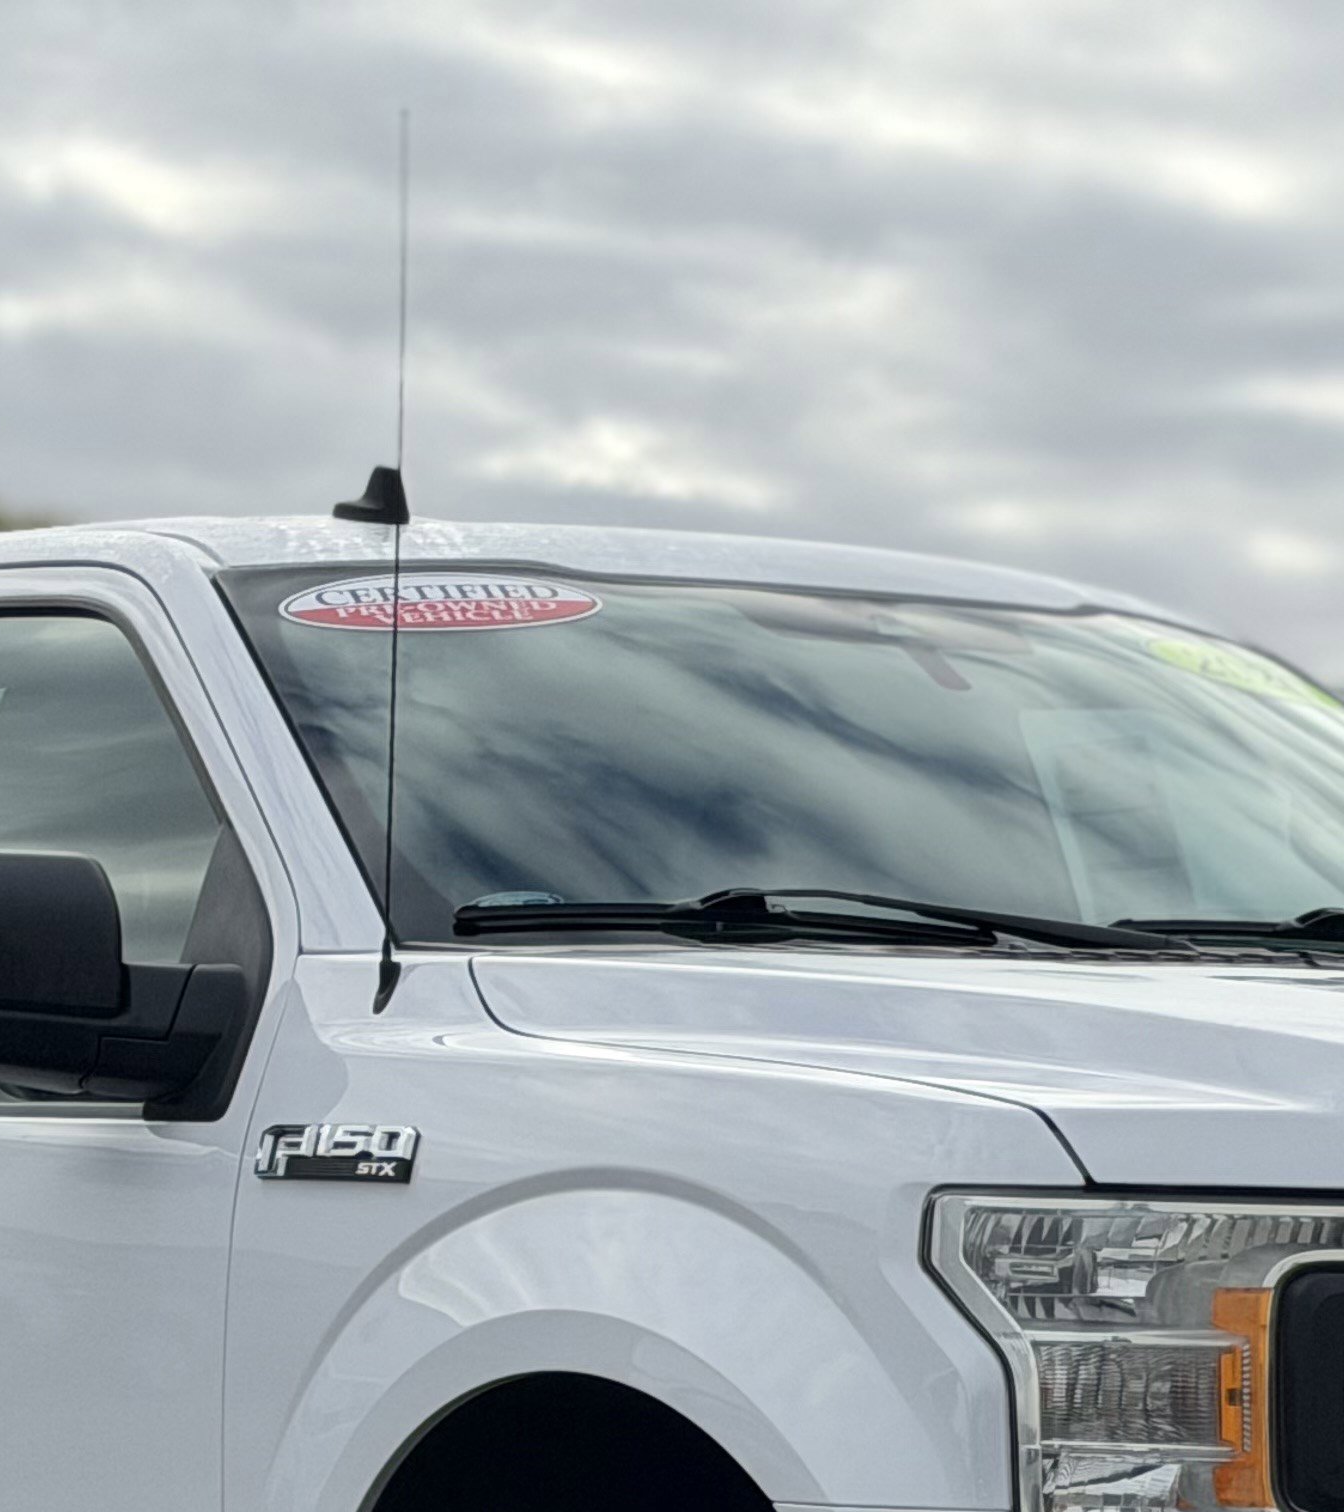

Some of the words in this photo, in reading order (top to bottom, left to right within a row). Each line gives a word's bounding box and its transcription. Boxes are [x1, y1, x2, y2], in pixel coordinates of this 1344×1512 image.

[315, 584, 559, 606] CERTIFIED
[375, 609, 535, 625] VEHICLE
[355, 1161, 398, 1177] STX
